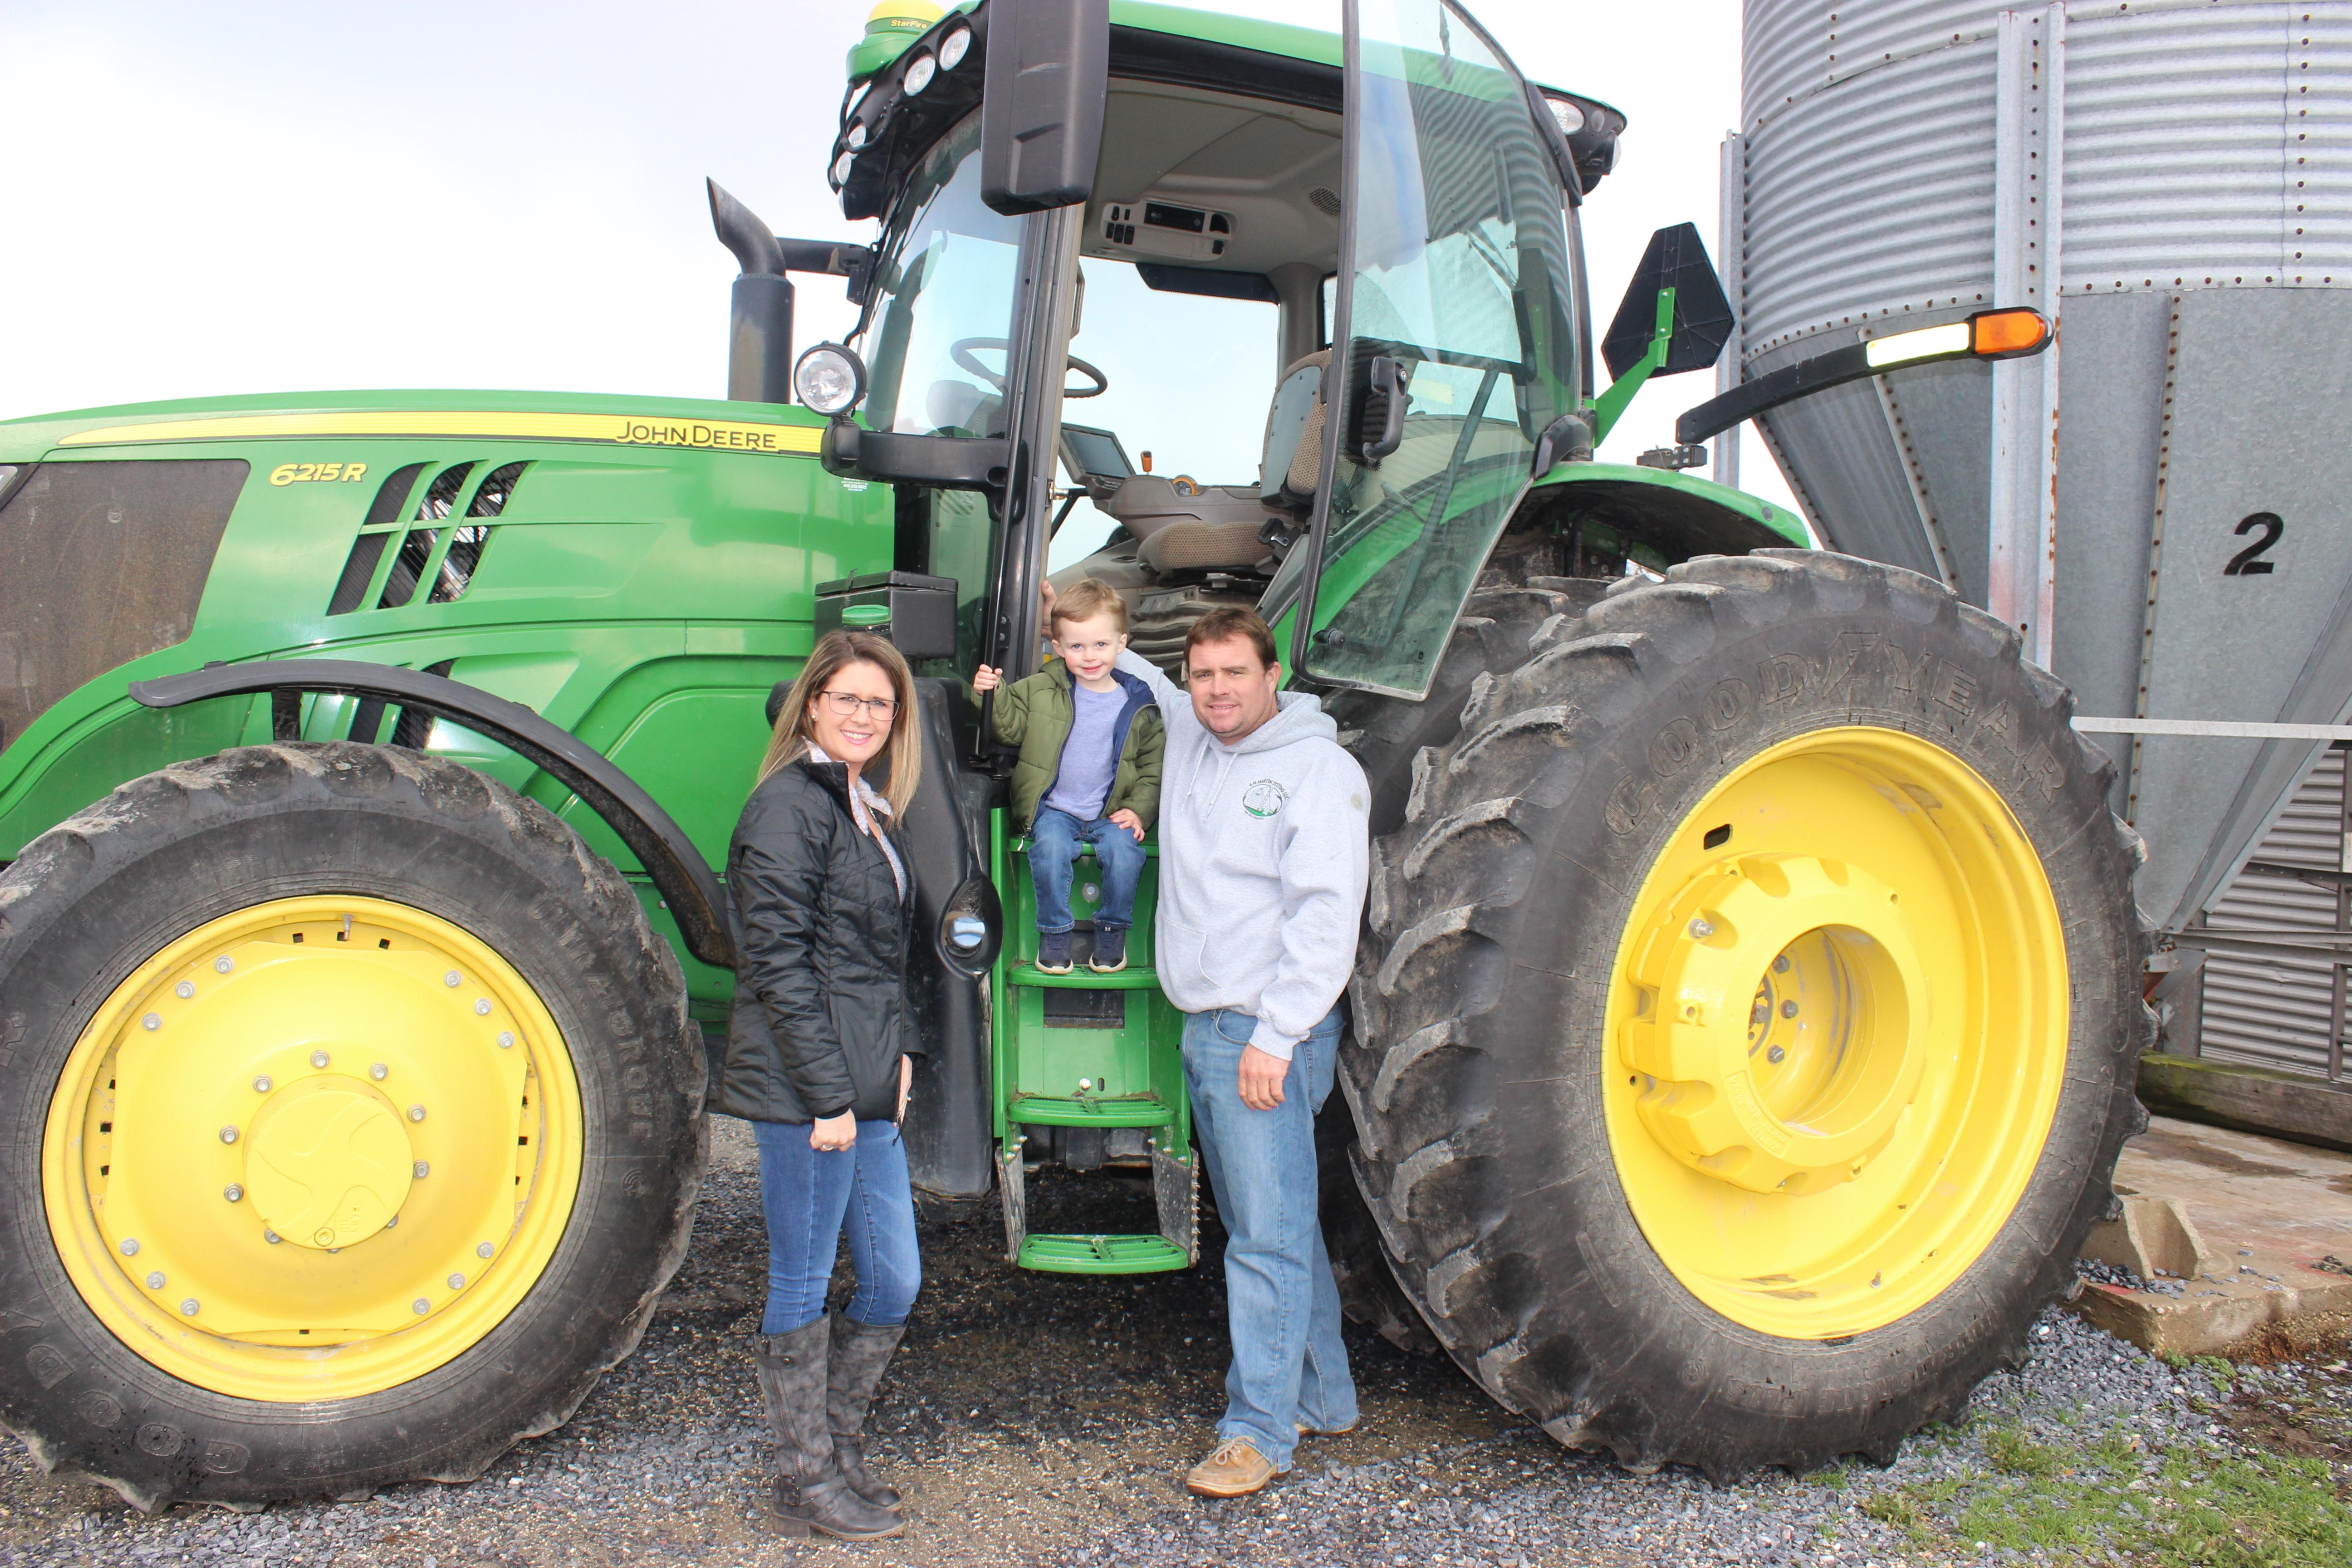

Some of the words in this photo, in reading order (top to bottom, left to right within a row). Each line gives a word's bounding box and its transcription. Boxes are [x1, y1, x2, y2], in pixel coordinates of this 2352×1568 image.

[891, 19, 927, 29] StarFire
[616, 421, 686, 443] JOHN
[692, 425, 777, 449] DEERE
[2224, 511, 2284, 576] 2
[1603, 632, 2066, 836] GOODYEAR
[1272, 781, 1286, 793] SYSTEMS
